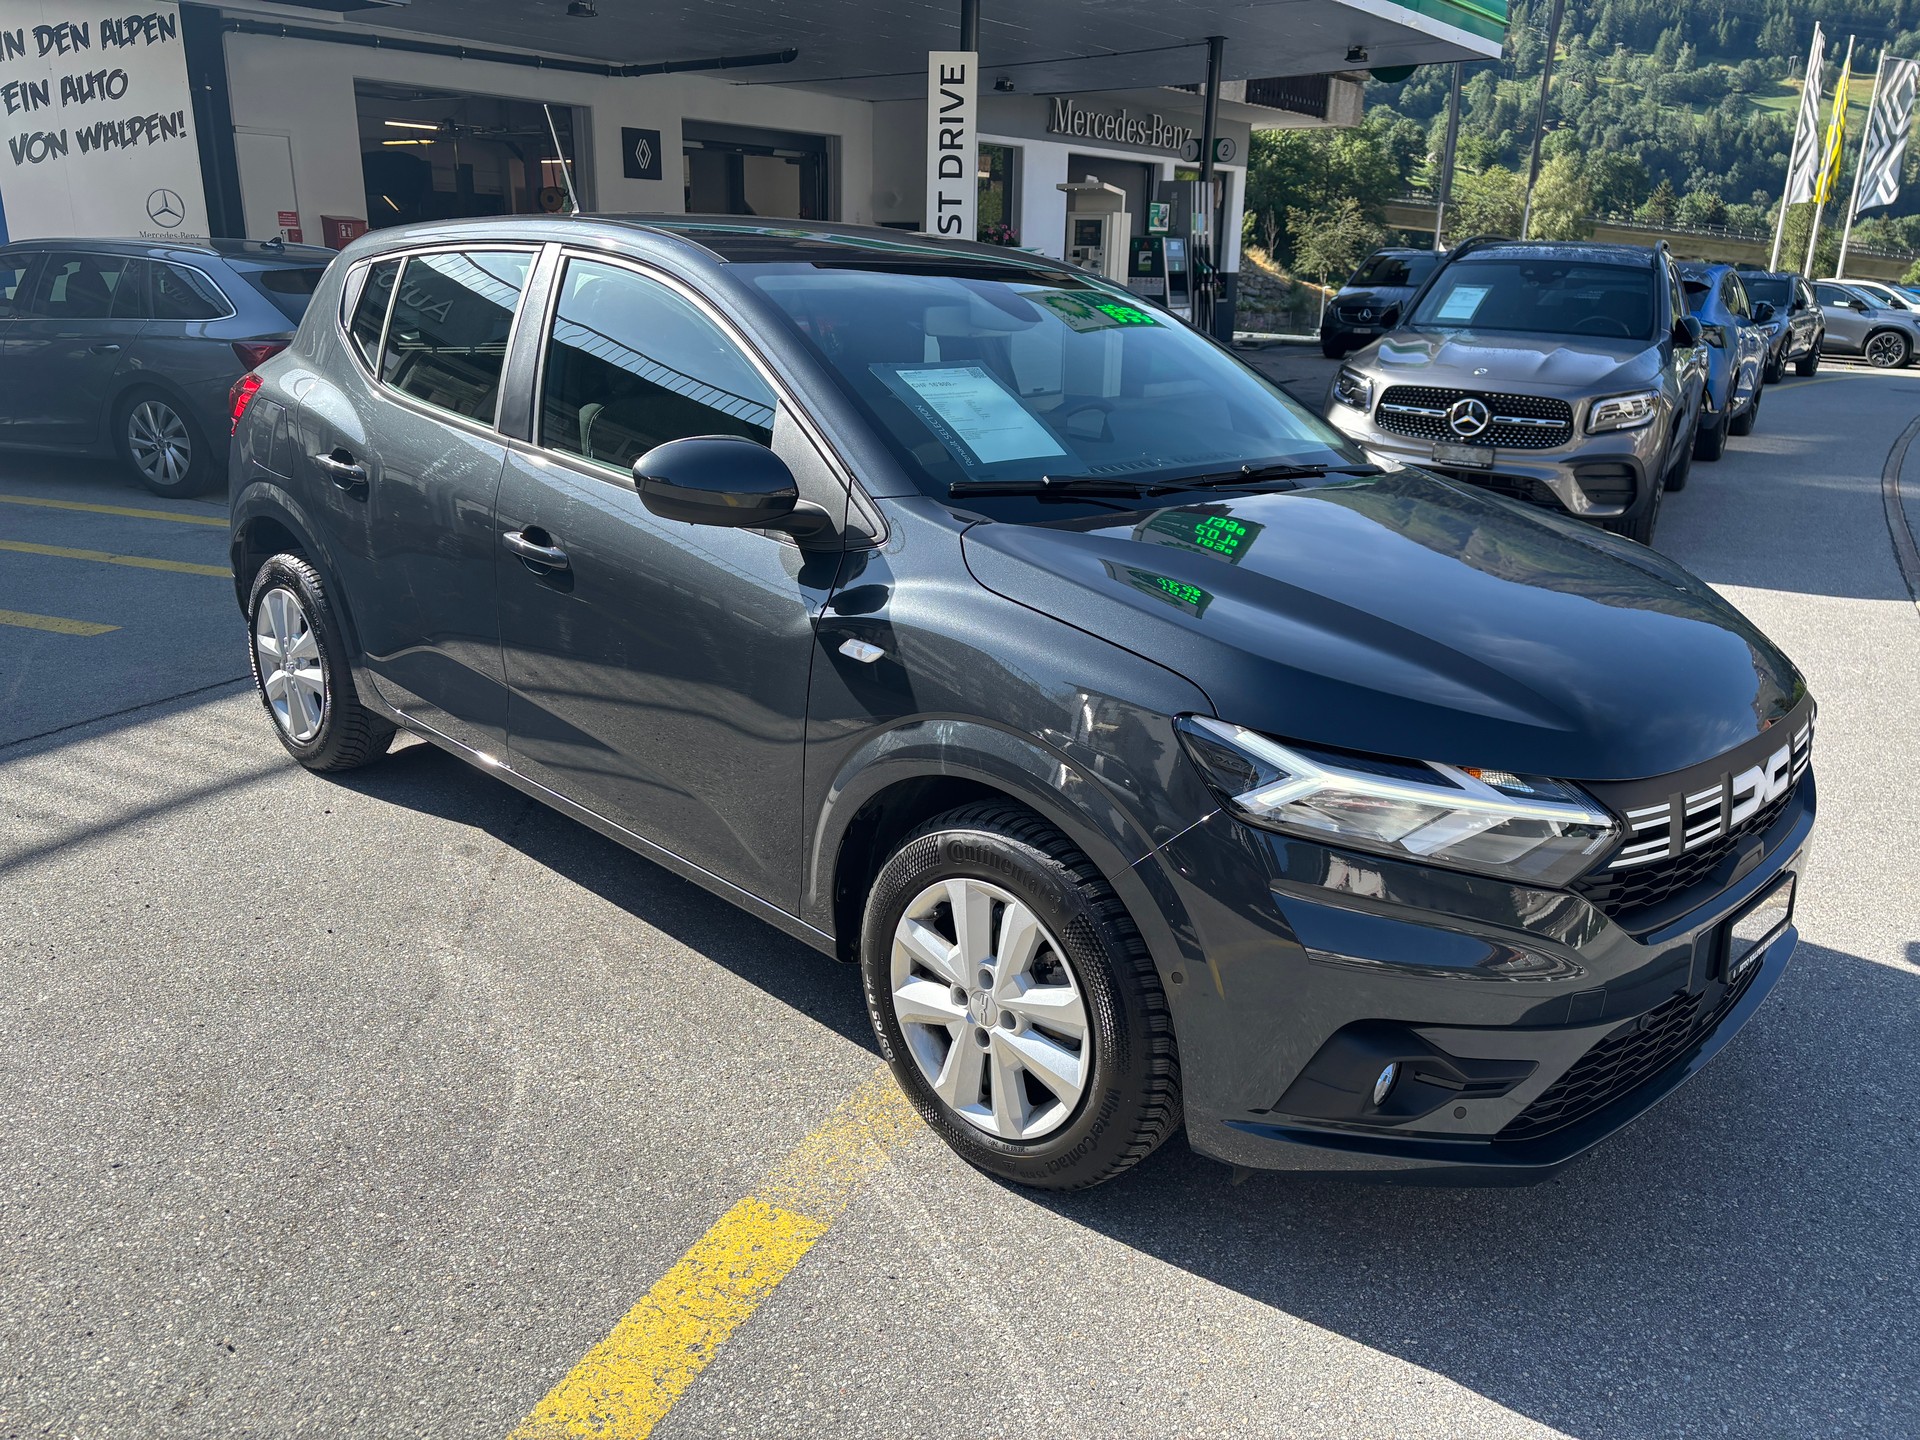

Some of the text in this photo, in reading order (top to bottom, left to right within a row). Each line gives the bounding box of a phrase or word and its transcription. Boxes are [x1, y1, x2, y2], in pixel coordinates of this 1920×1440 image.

[32, 22, 91, 57] DEN
[100, 13, 177, 51] ALPEN
[1, 68, 129, 116] EIN AUTO
[8, 110, 188, 166] VON WALPEN!
[938, 64, 966, 180] DRIVE
[1052, 97, 1193, 150] Mercedes-Benz
[1186, 144, 1192, 157] 1
[1222, 144, 1230, 157] 2
[139, 230, 200, 239] Mercedes-Benz
[915, 404, 951, 441] SELECTION
[946, 839, 1051, 899] Continental
[1045, 1087, 1122, 1176] WinterContact
